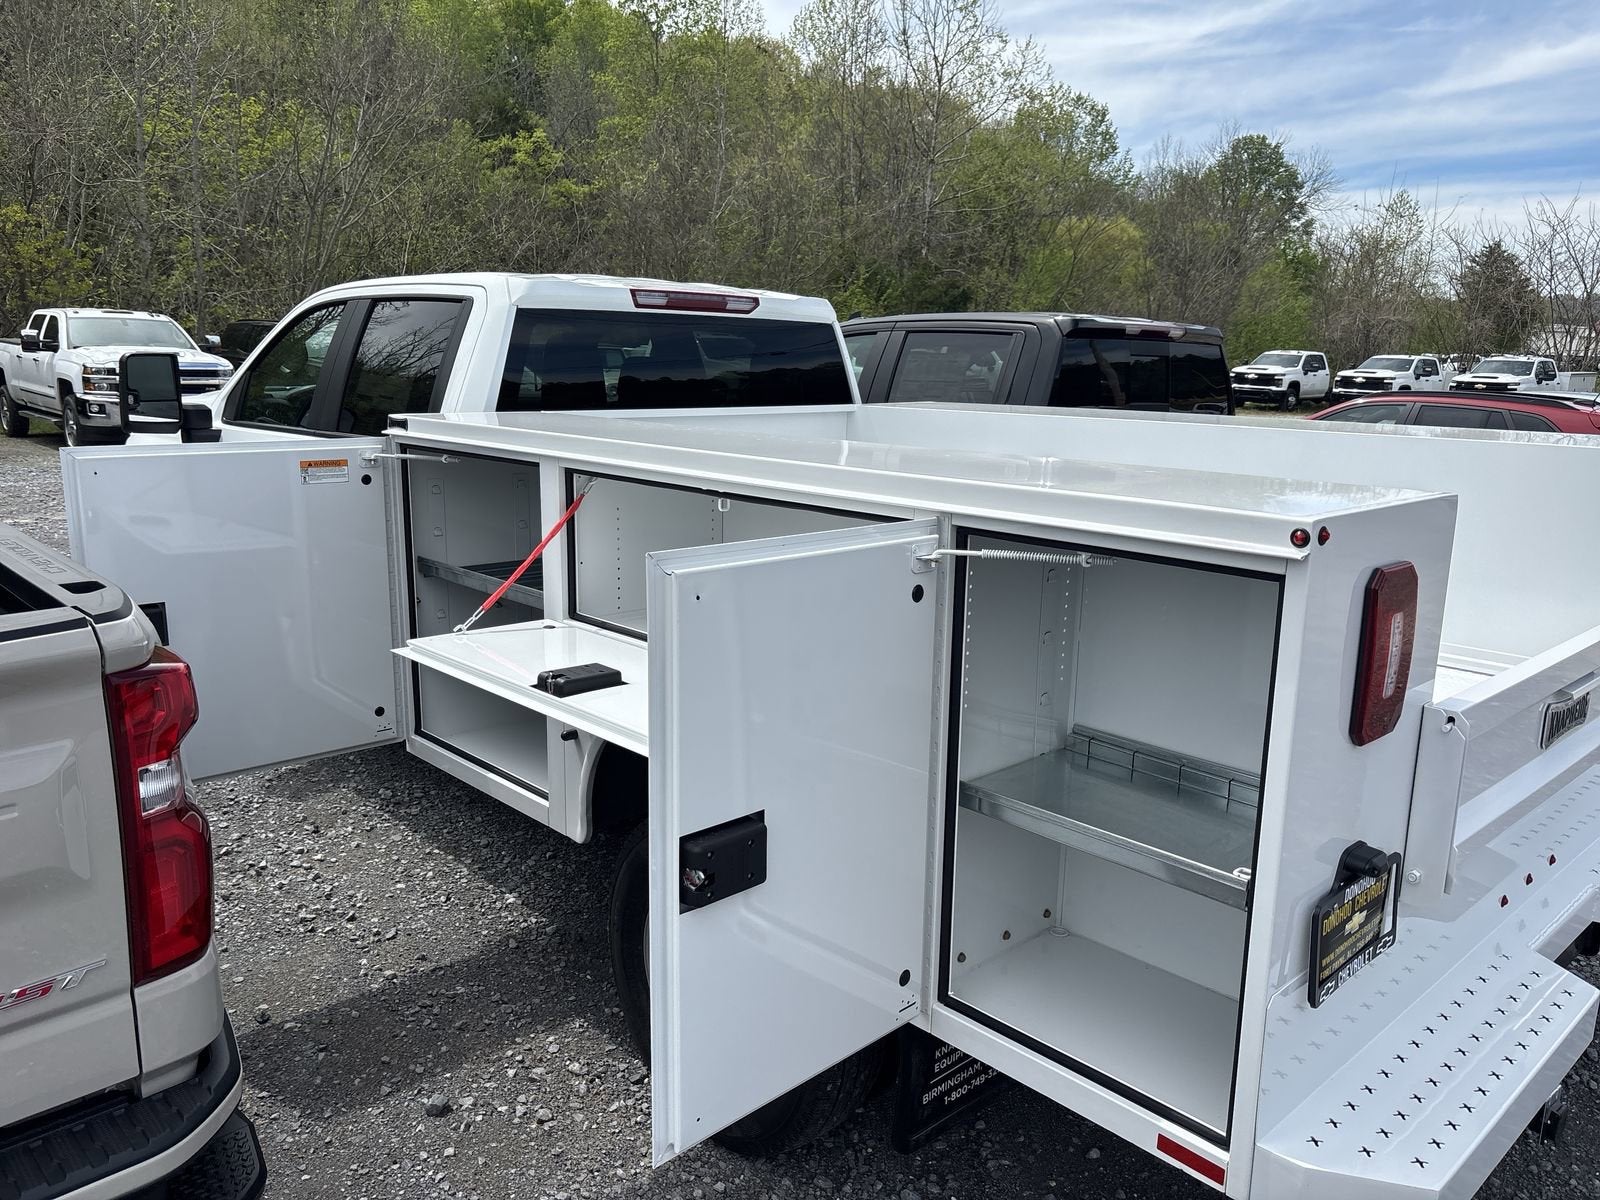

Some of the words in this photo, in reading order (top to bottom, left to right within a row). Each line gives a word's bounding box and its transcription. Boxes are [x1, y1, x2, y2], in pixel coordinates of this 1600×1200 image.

[1322, 900, 1352, 936] DONOHOO
[1354, 873, 1388, 912] CHEVROLET
[0, 959, 107, 1010] ST
[1338, 946, 1374, 987] CHEVROLET
[922, 1061, 983, 1105] BIRMINGHAM,
[934, 1050, 964, 1073] EQUIP
